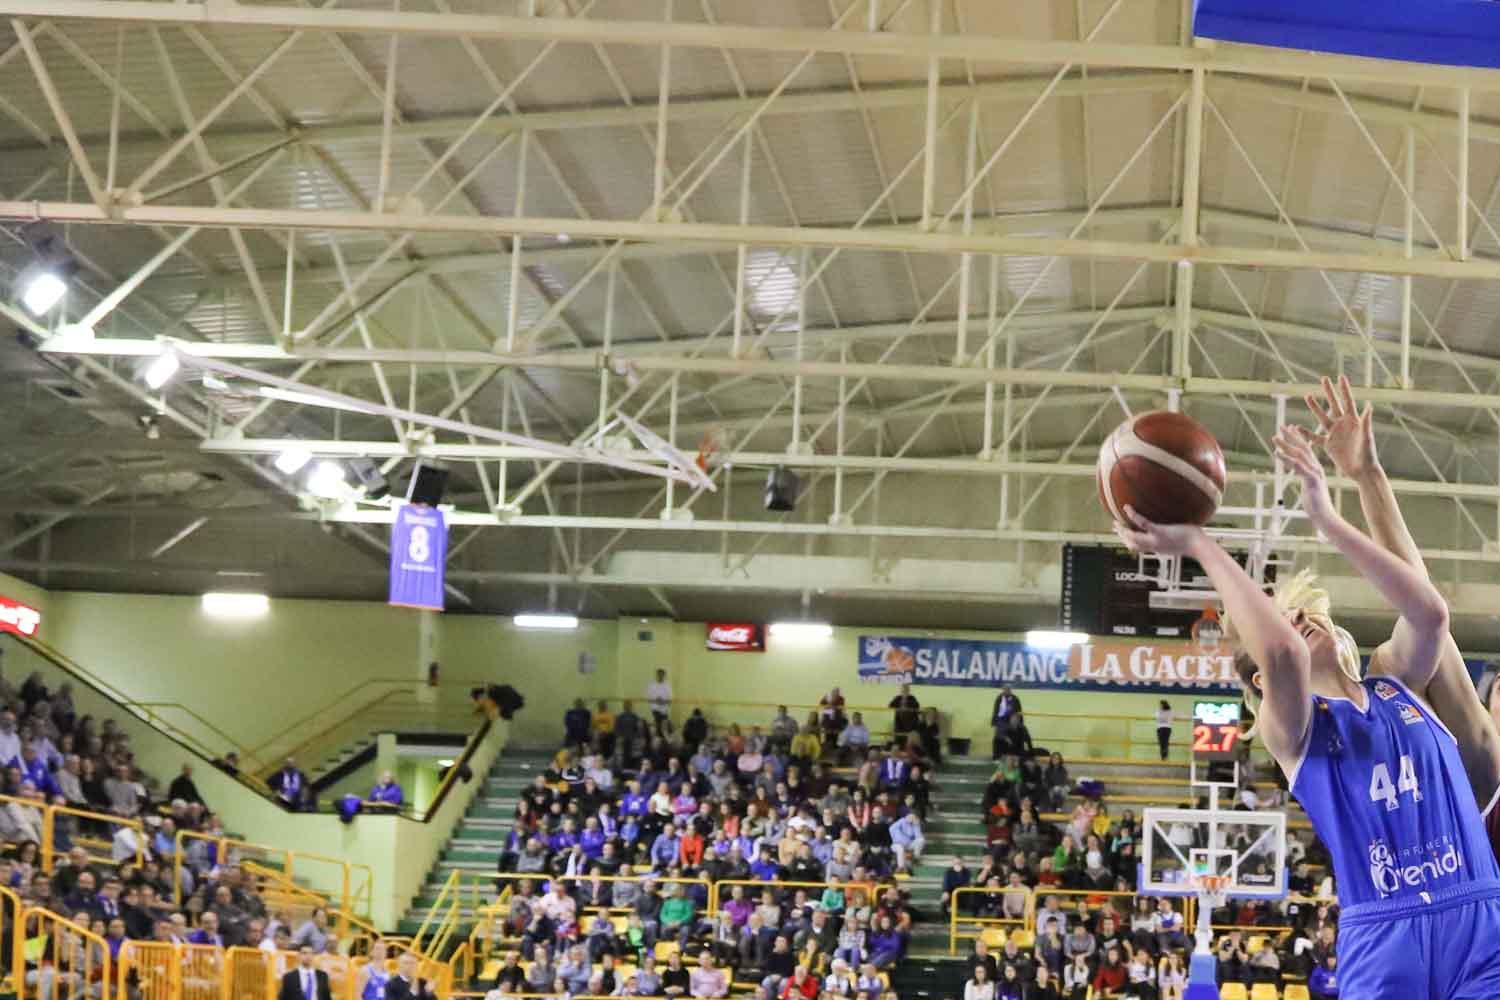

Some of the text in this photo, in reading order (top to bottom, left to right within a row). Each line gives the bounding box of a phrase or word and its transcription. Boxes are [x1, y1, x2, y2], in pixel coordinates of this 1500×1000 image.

[408, 526, 430, 562] 8
[1114, 571, 1146, 583] LOCA
[916, 648, 1070, 684] SALAMANC
[1129, 645, 1238, 683] GACET
[1193, 725, 1238, 752] 2.7
[1369, 755, 1423, 812] 44
